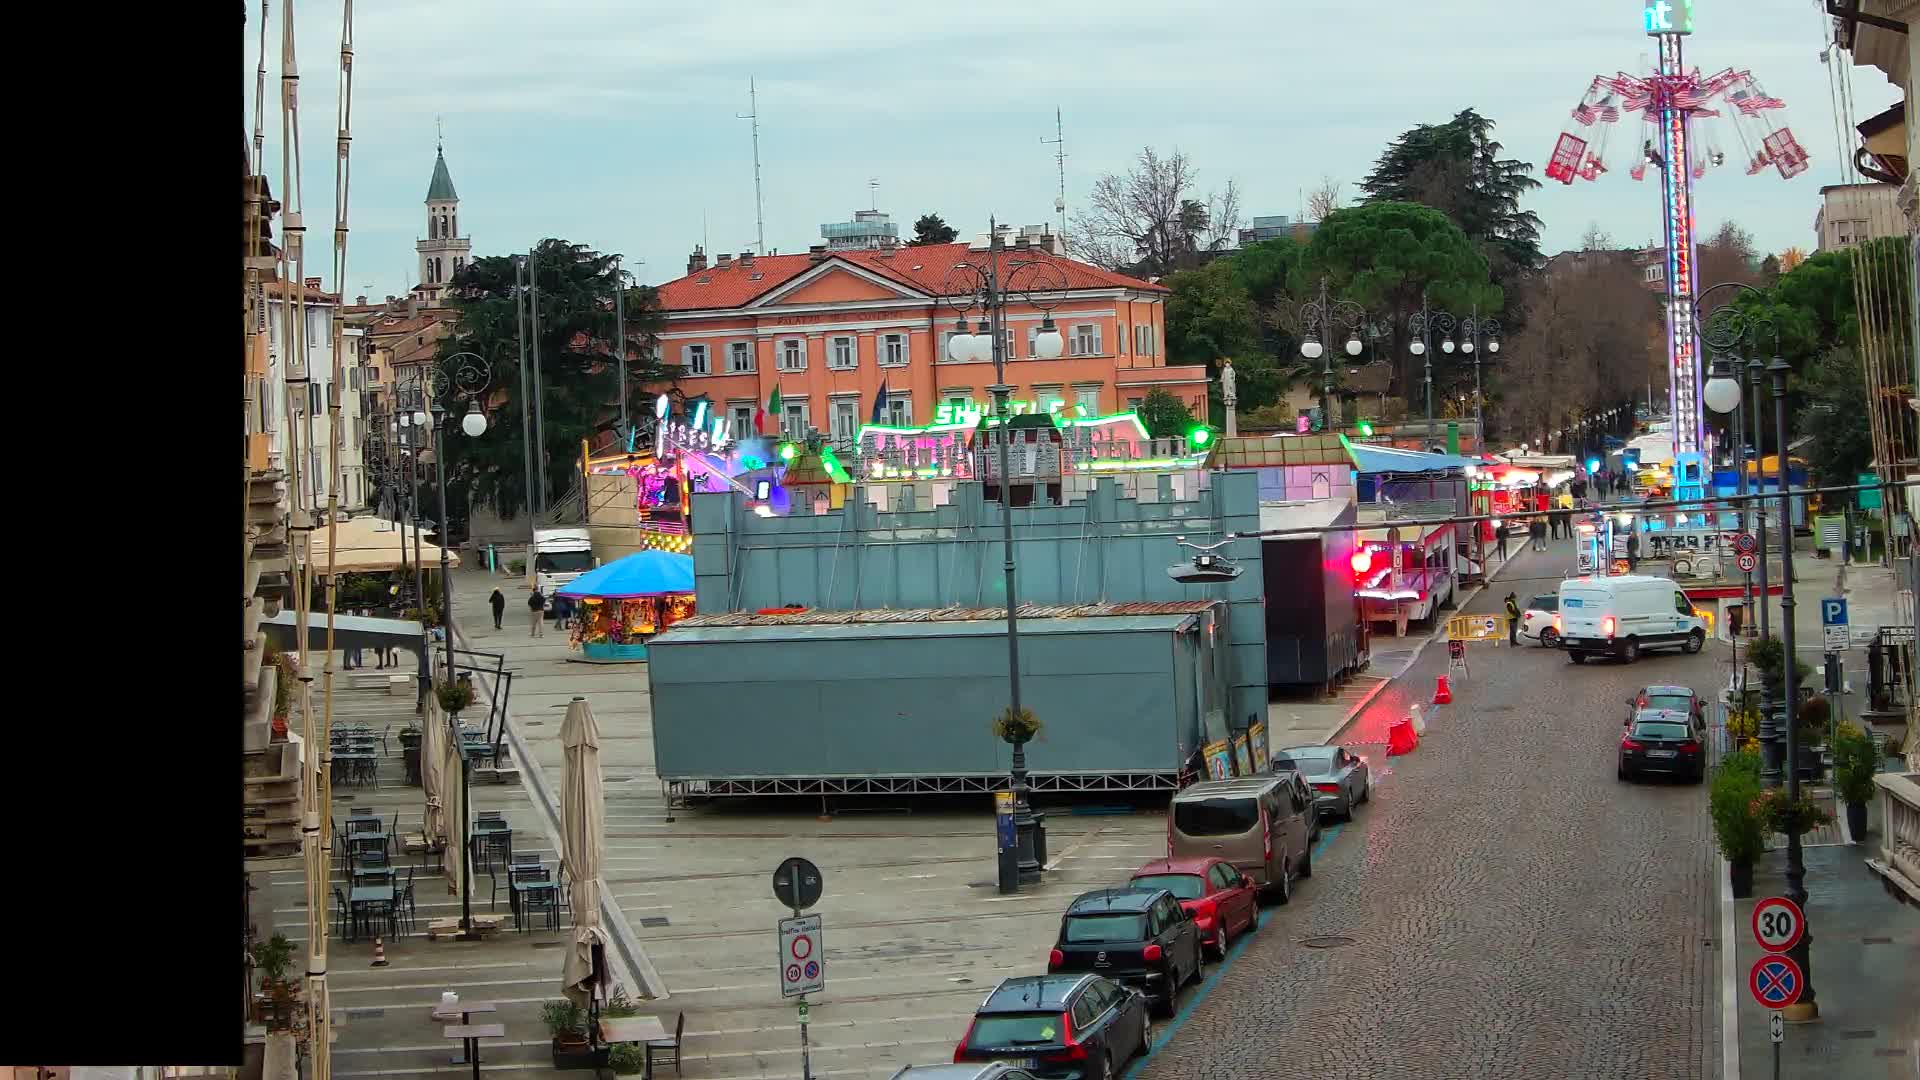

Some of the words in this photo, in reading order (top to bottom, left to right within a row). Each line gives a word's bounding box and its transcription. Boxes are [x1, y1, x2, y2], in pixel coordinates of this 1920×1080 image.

[1742, 558, 1752, 567] 20
[1827, 602, 1842, 622] P
[1762, 912, 1792, 937] 30
